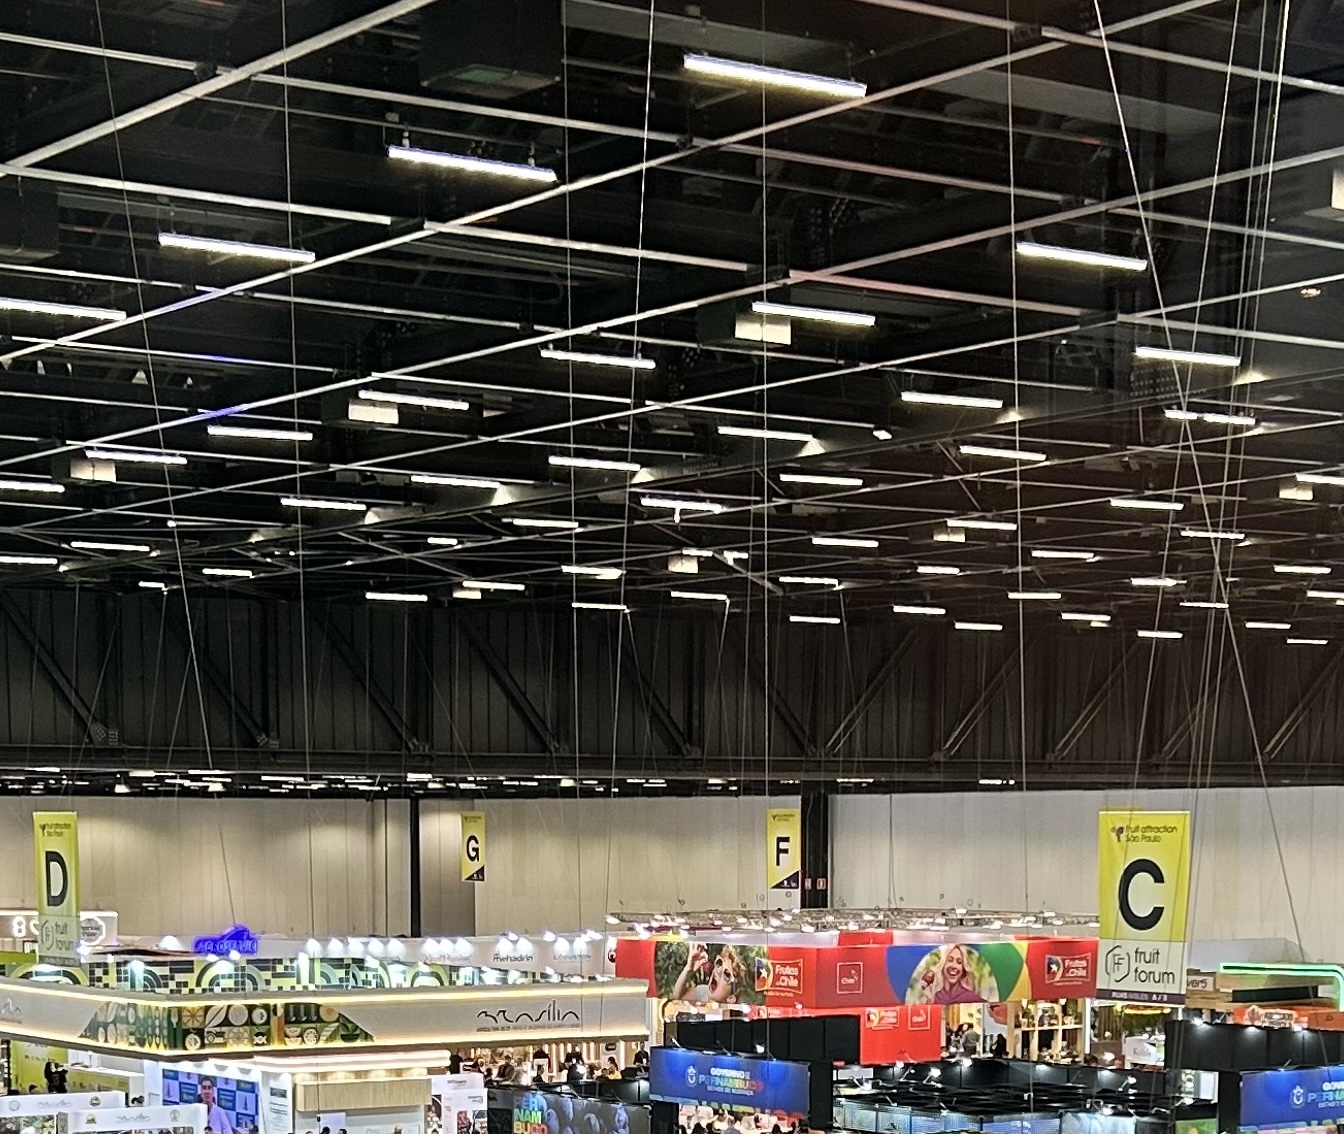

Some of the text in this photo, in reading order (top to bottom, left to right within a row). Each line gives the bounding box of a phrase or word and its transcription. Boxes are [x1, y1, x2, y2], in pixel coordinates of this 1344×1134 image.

[466, 835, 479, 862] G
[775, 836, 790, 866] F
[45, 850, 68, 906] D
[1118, 859, 1165, 931] C
[1135, 947, 1160, 965] fruit
[1134, 968, 1176, 985] forum
